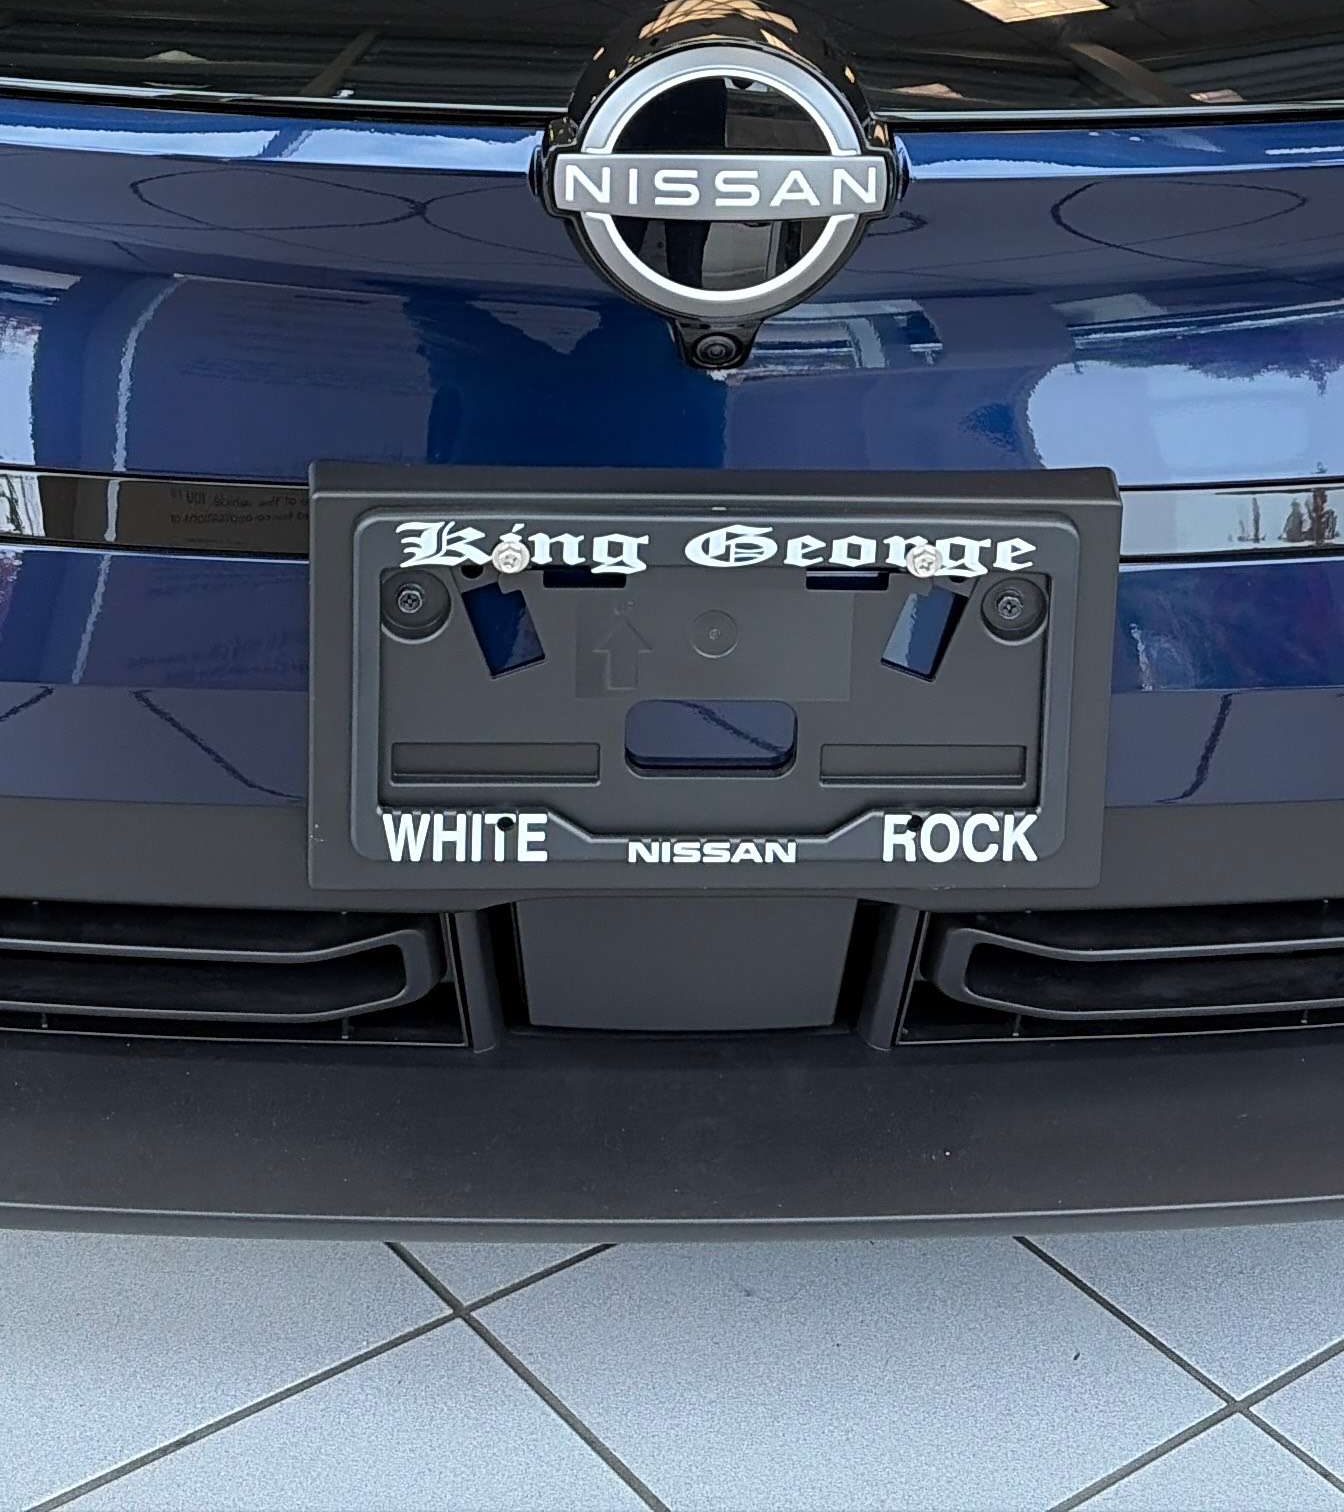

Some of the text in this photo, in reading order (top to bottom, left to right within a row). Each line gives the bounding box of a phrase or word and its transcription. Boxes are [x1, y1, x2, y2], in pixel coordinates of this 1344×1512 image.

[565, 165, 877, 207] NISSAN
[684, 524, 1037, 577] George
[382, 813, 1038, 863] WHITE NISSAN ROCK
